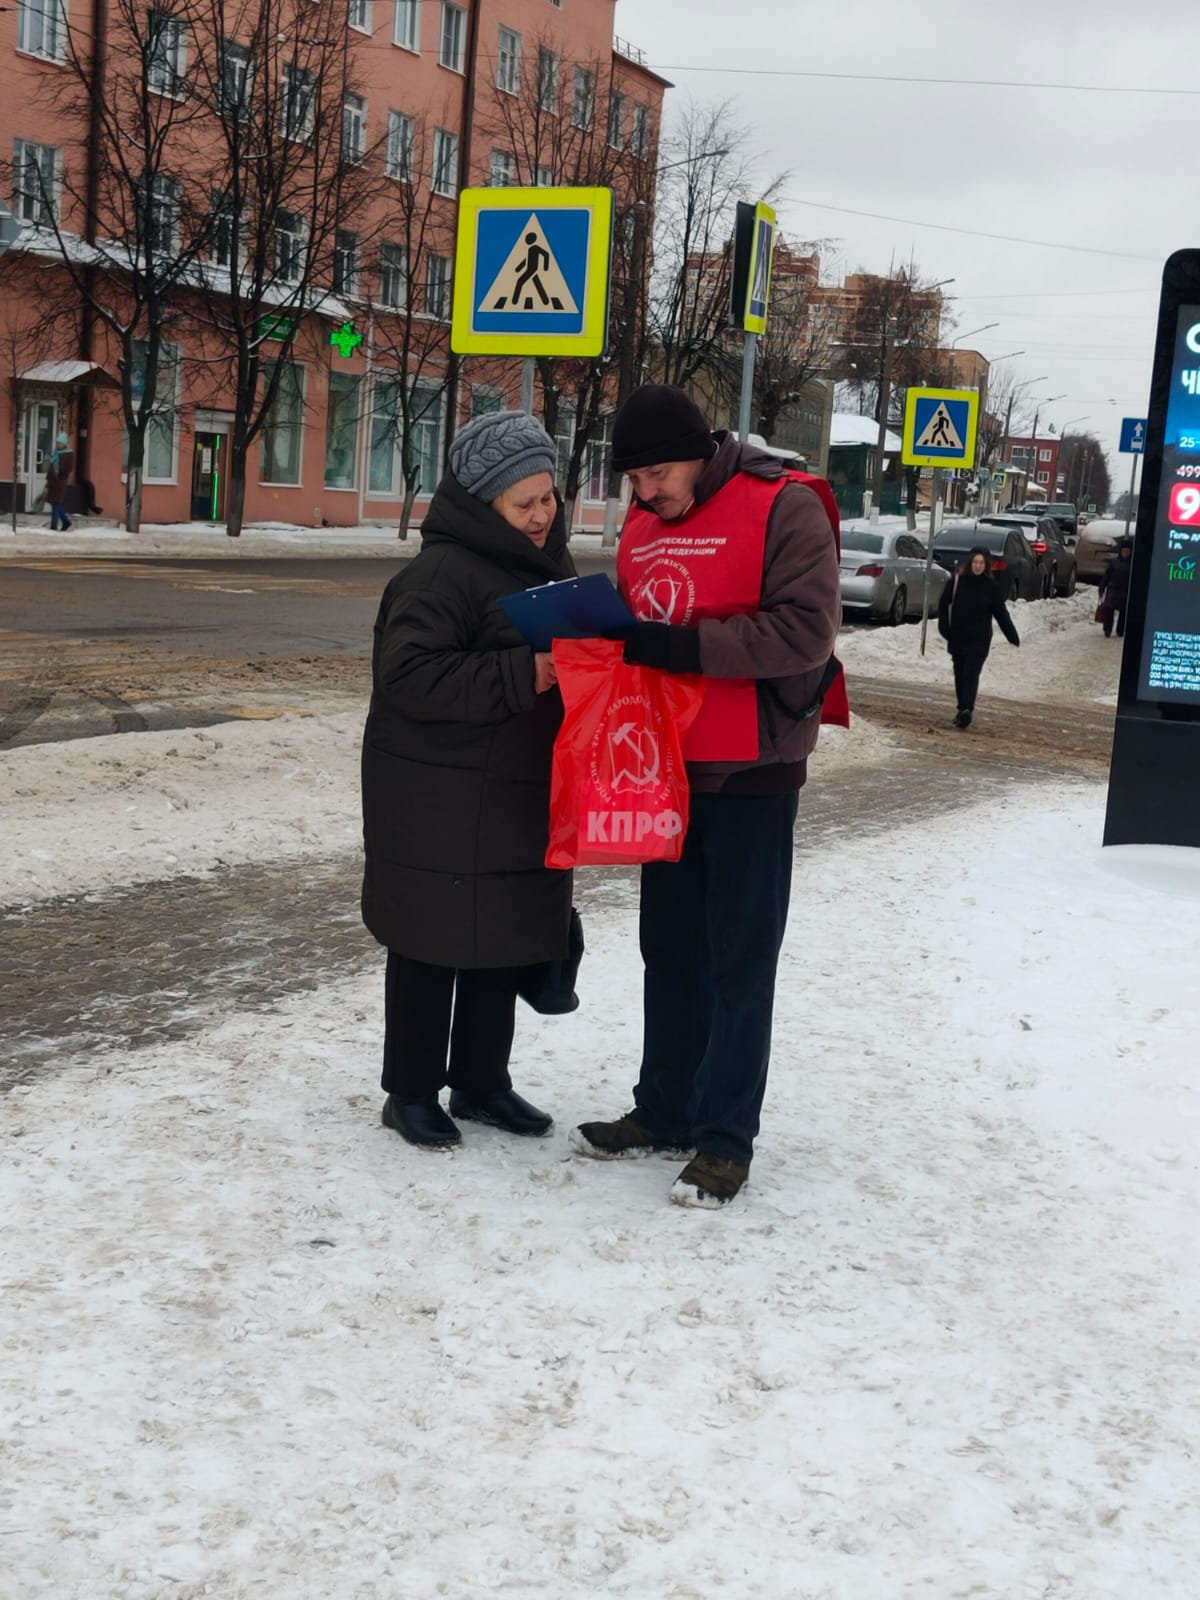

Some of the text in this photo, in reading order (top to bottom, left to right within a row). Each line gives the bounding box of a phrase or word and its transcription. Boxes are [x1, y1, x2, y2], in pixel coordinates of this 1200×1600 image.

[694, 537, 727, 546] ПАРТИЯ
[667, 547, 717, 556] ФЕДЕРАЦИИ
[587, 809, 682, 843] КПРФ
